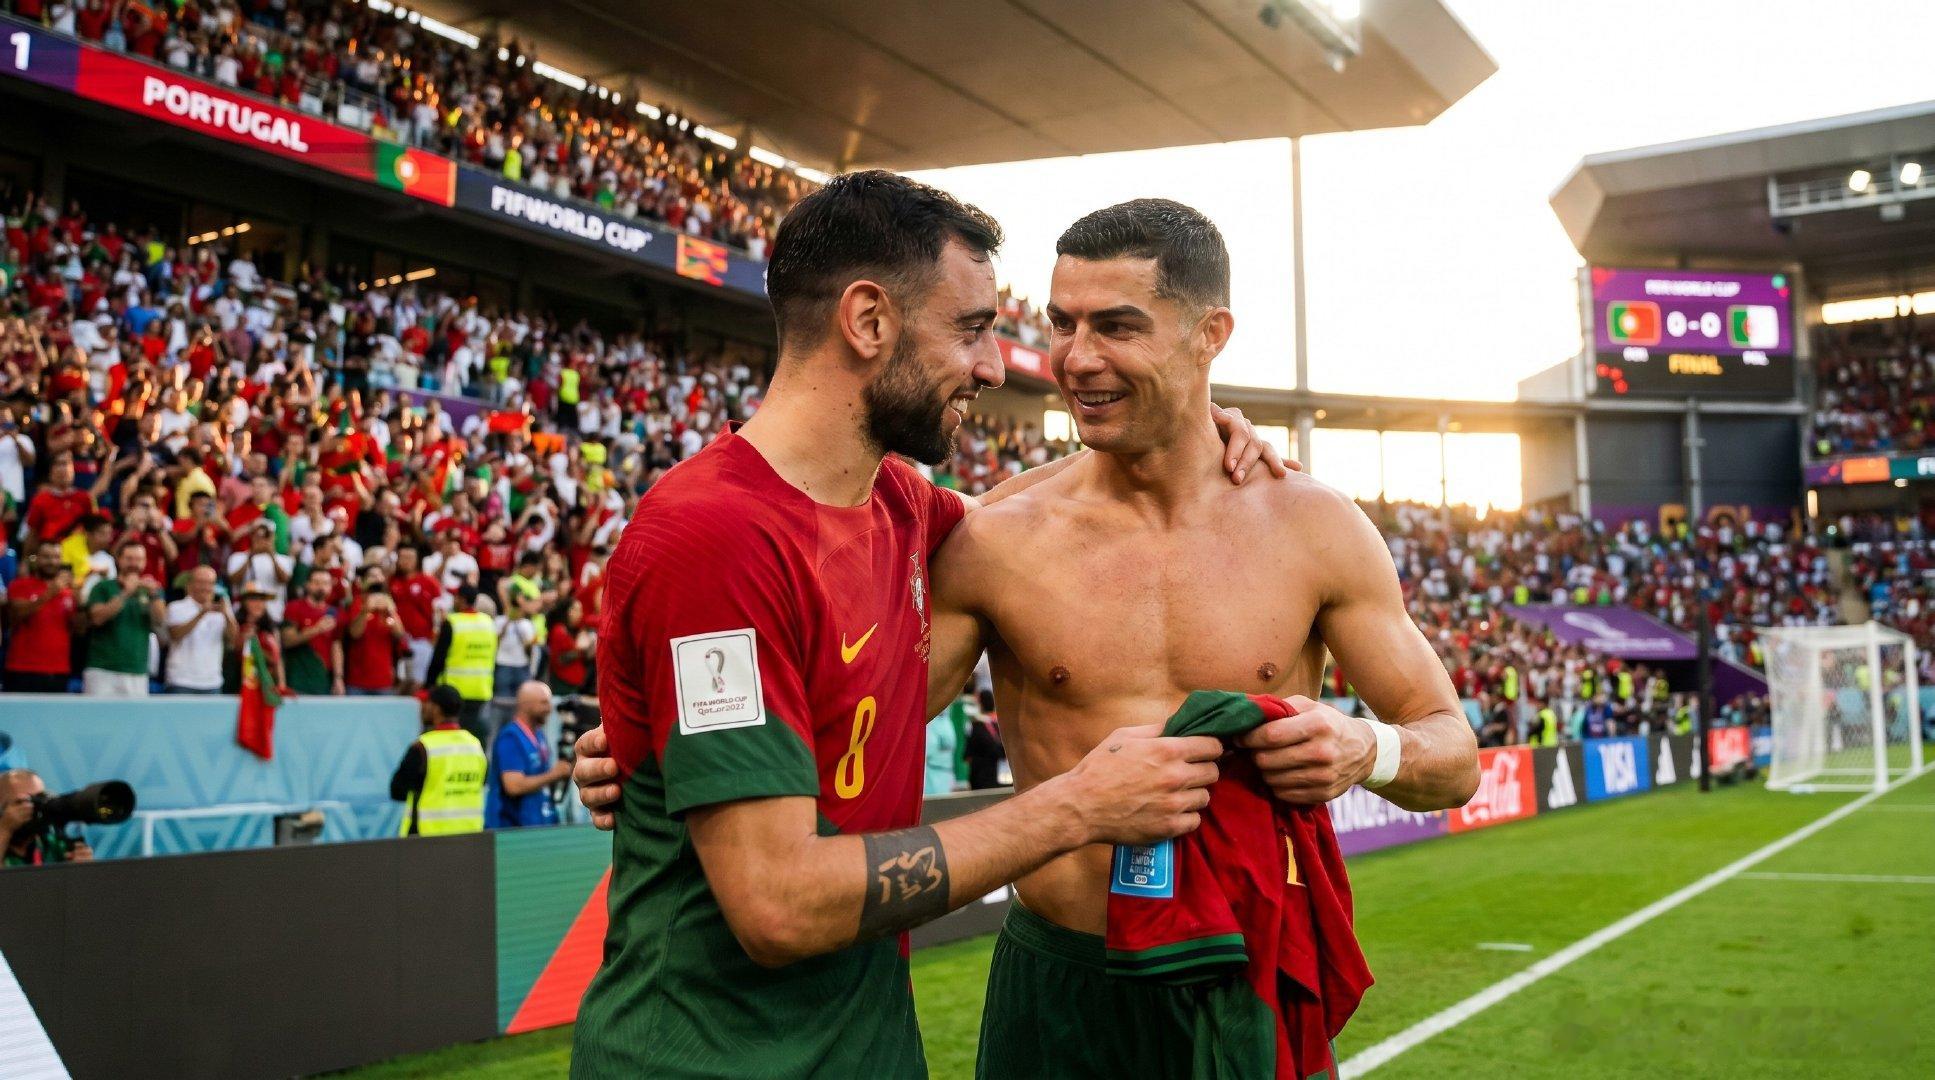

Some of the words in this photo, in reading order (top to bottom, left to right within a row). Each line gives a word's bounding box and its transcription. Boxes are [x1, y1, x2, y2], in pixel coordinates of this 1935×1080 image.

[10, 32, 31, 71] 1
[143, 76, 309, 153] PORTUGAL
[708, 697, 734, 706] WORLD
[734, 695, 748, 703] CUP
[834, 695, 877, 799] 8
